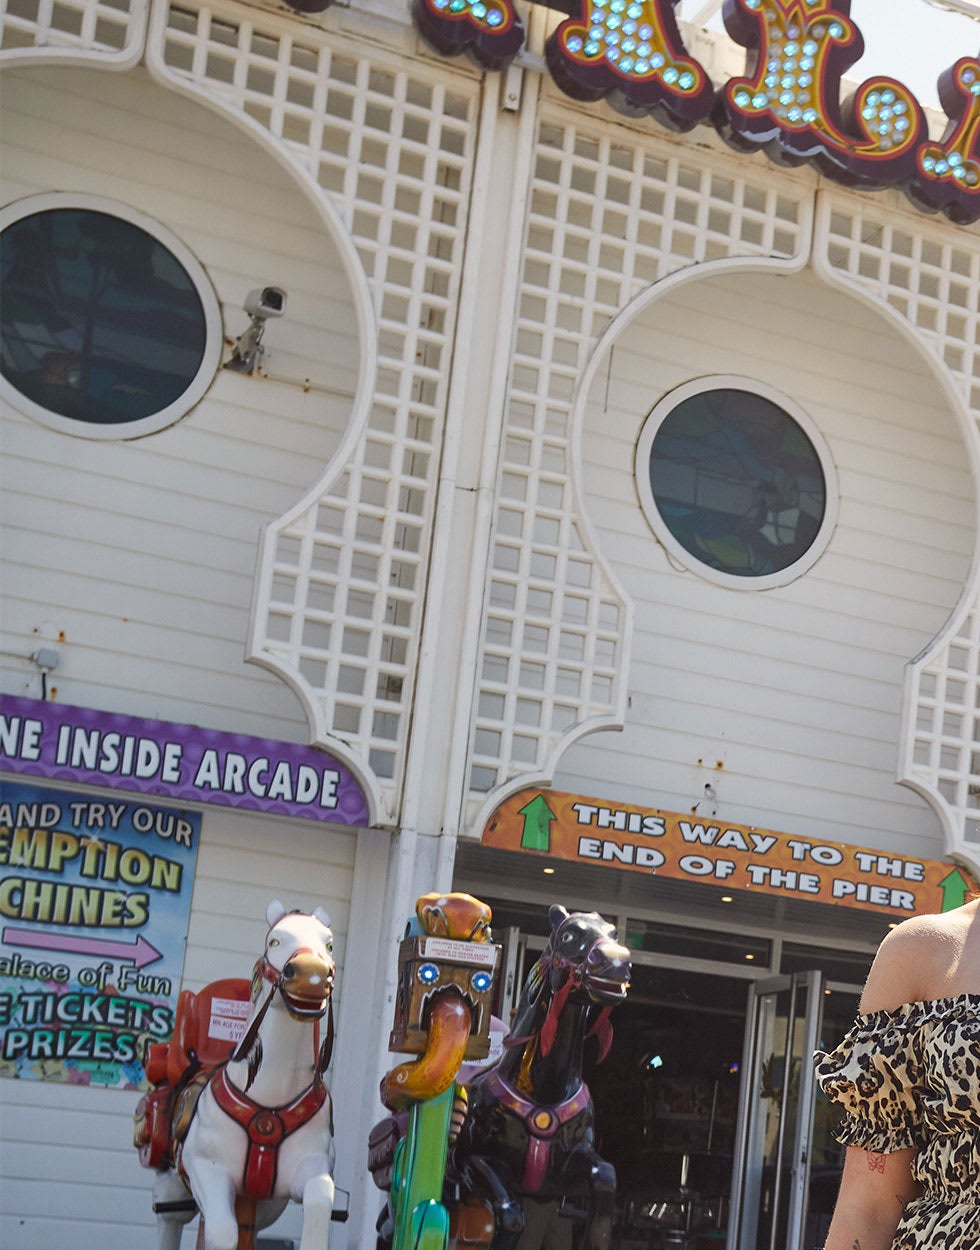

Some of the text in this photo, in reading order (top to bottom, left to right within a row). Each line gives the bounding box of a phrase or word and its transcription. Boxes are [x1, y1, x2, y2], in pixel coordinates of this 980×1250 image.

[56, 725, 182, 784] INSIDE
[194, 749, 341, 809] ARCADE
[70, 802, 126, 829] TRY
[132, 807, 194, 849] OUR
[571, 802, 925, 882] THIS WAY TO THE
[576, 836, 917, 912] END OF THE PIER
[78, 961, 113, 992] of
[118, 965, 172, 997] Fun
[18, 992, 175, 1038] TICKETS
[4, 1028, 138, 1064] PRIZES
